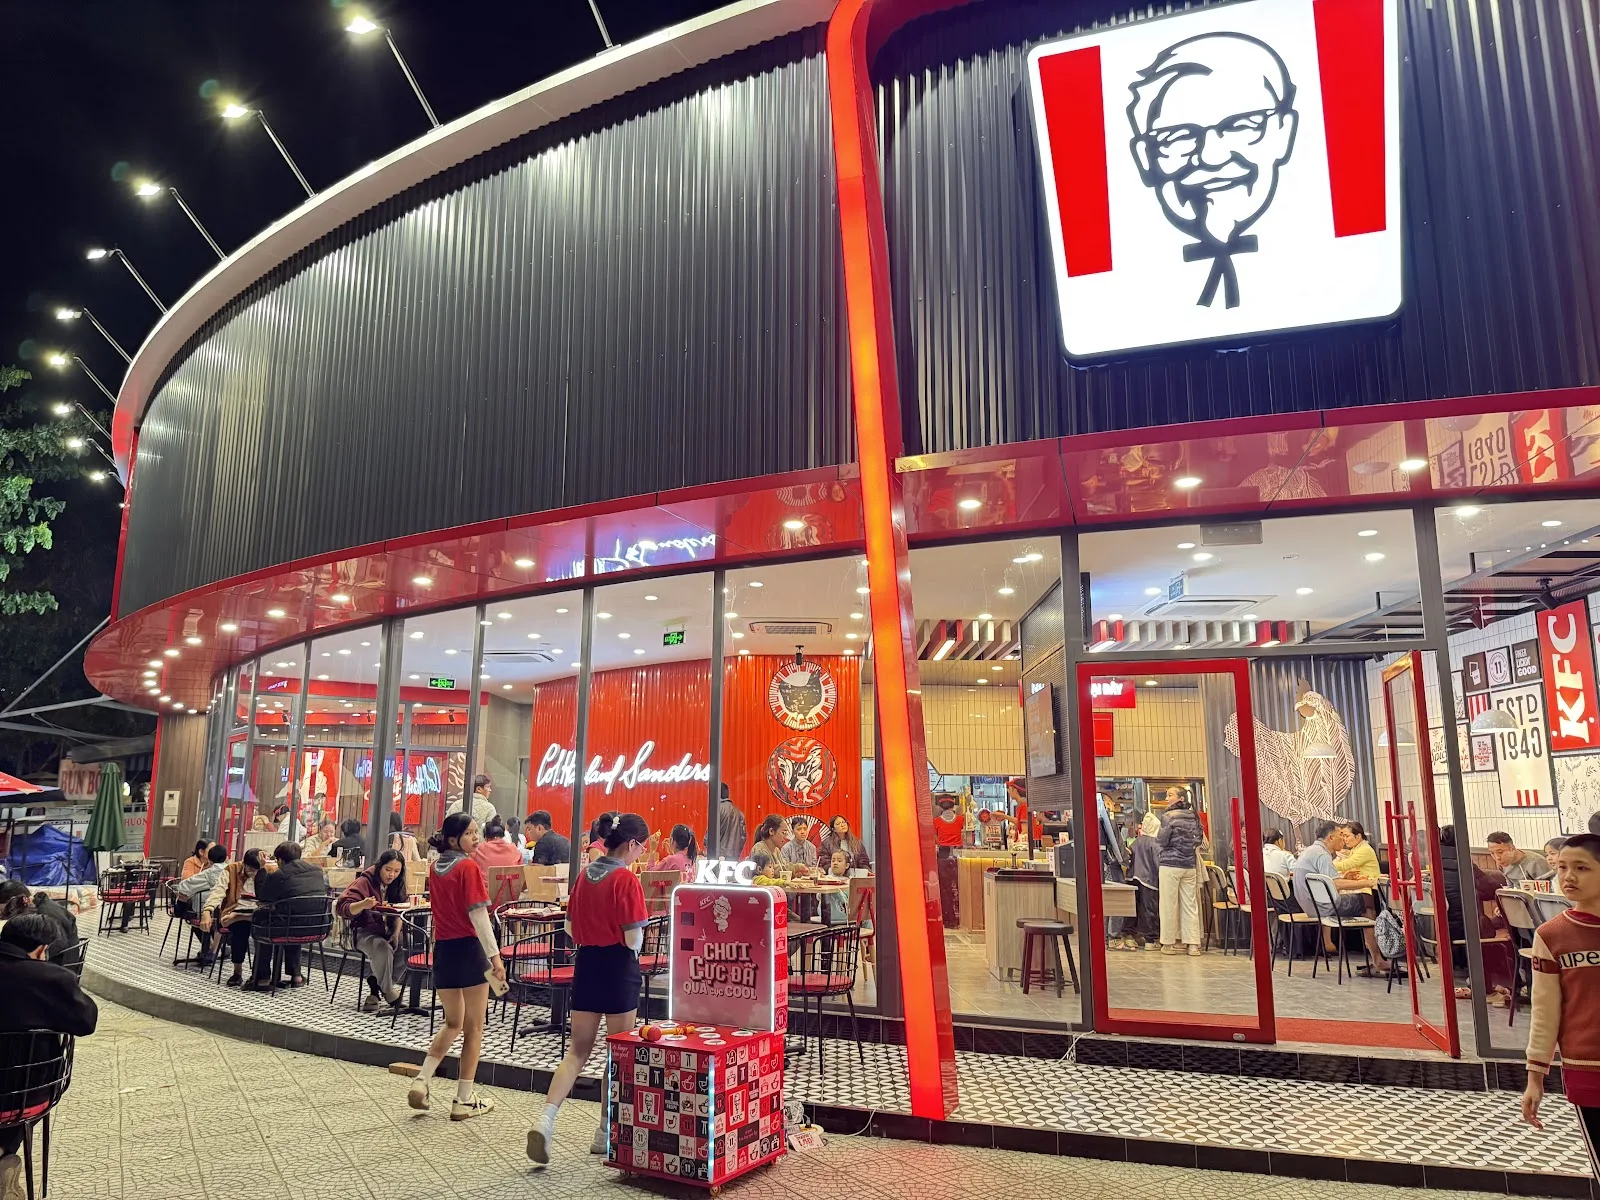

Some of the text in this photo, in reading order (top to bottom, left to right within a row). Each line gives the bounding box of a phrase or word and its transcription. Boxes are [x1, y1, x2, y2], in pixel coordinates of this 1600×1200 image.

[1518, 665, 1538, 677] GOOD
[1548, 613, 1590, 743] KFC
[1499, 726, 1542, 760] 1940
[695, 859, 757, 885] KFC
[700, 896, 711, 906] KFC
[703, 941, 752, 962] CHƠI
[724, 984, 757, 1000] COOL
[642, 1114, 656, 1123] KFC
